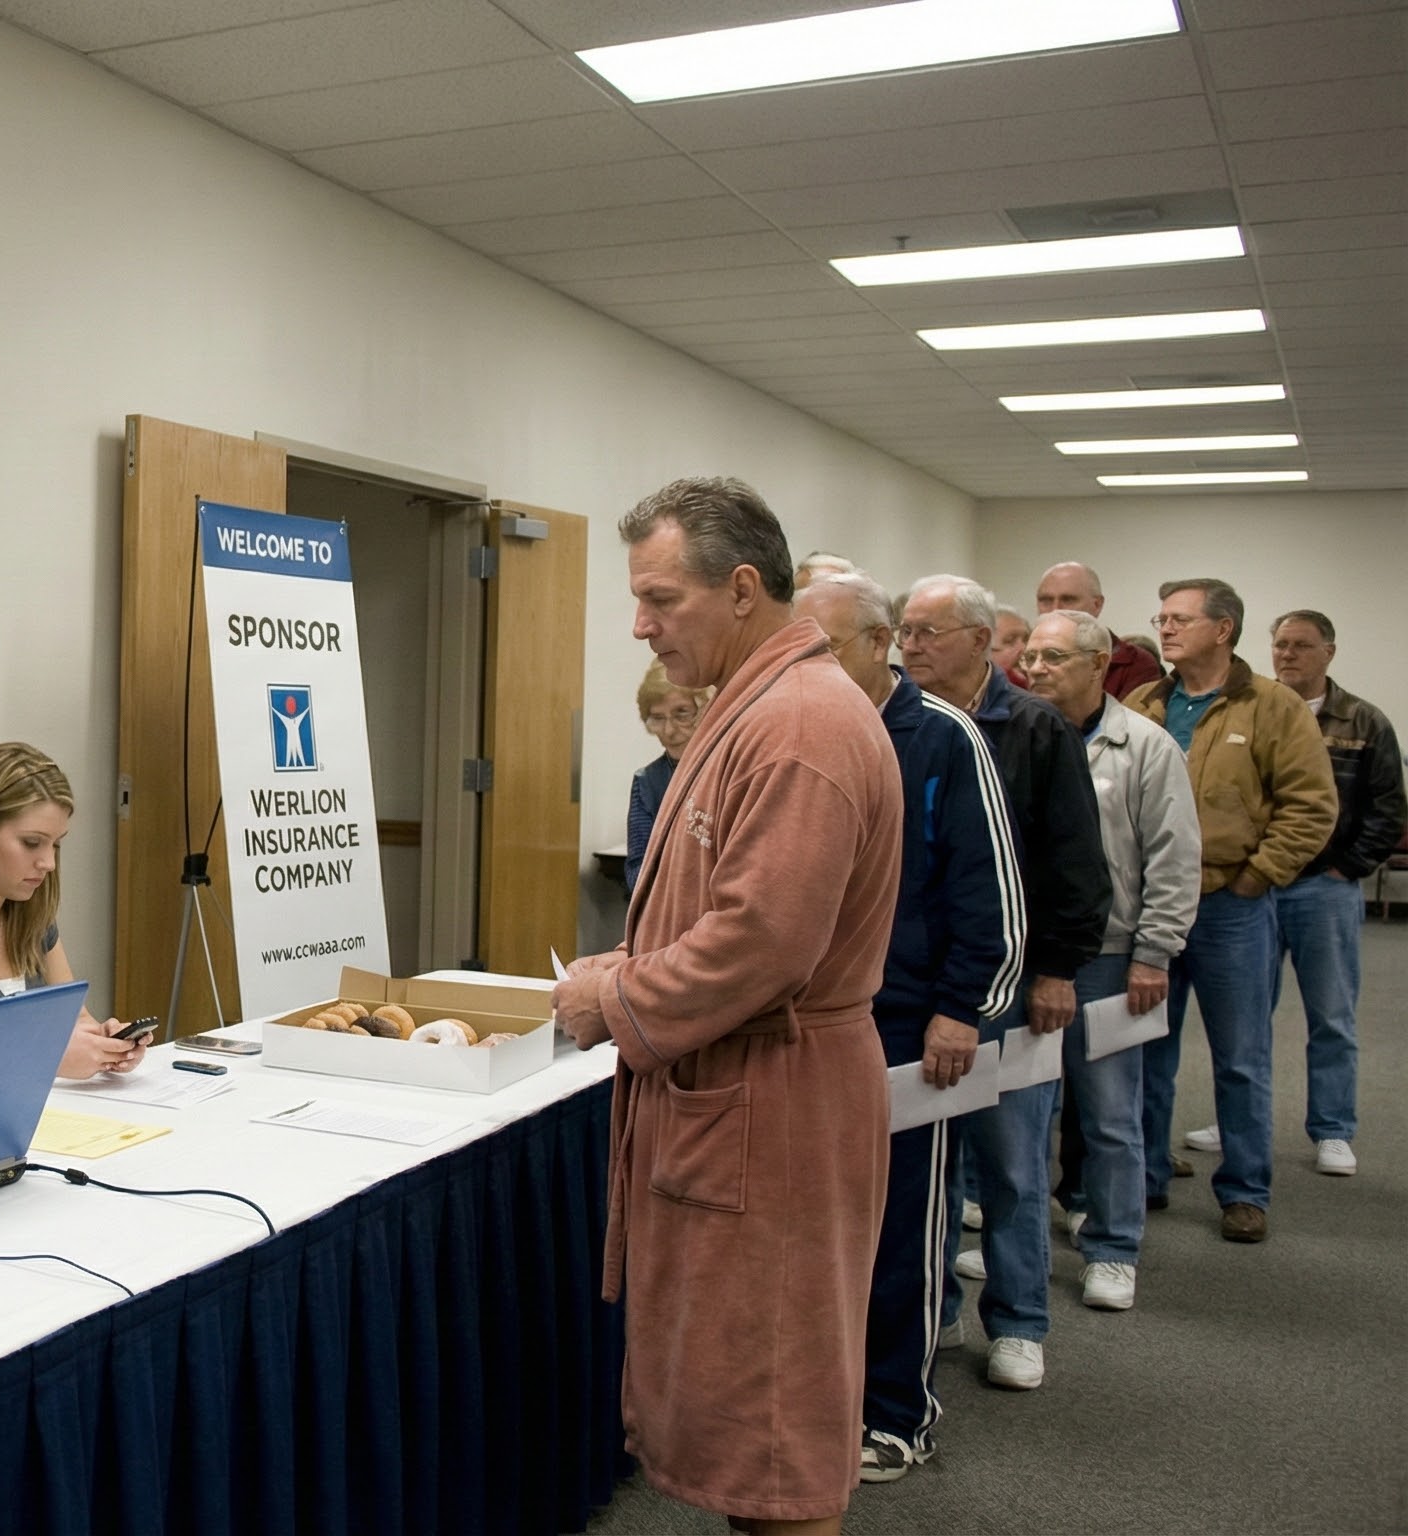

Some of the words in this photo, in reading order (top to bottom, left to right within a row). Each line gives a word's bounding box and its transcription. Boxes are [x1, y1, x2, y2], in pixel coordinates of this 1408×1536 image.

[216, 526, 306, 563] WELCOME
[307, 540, 332, 565] TO
[228, 613, 342, 653] SPONSOR
[250, 788, 347, 818] WERLION
[244, 823, 360, 857] INSURANCE
[254, 858, 353, 894] COMPANY
[261, 935, 366, 965] www.ccwaaa.com
